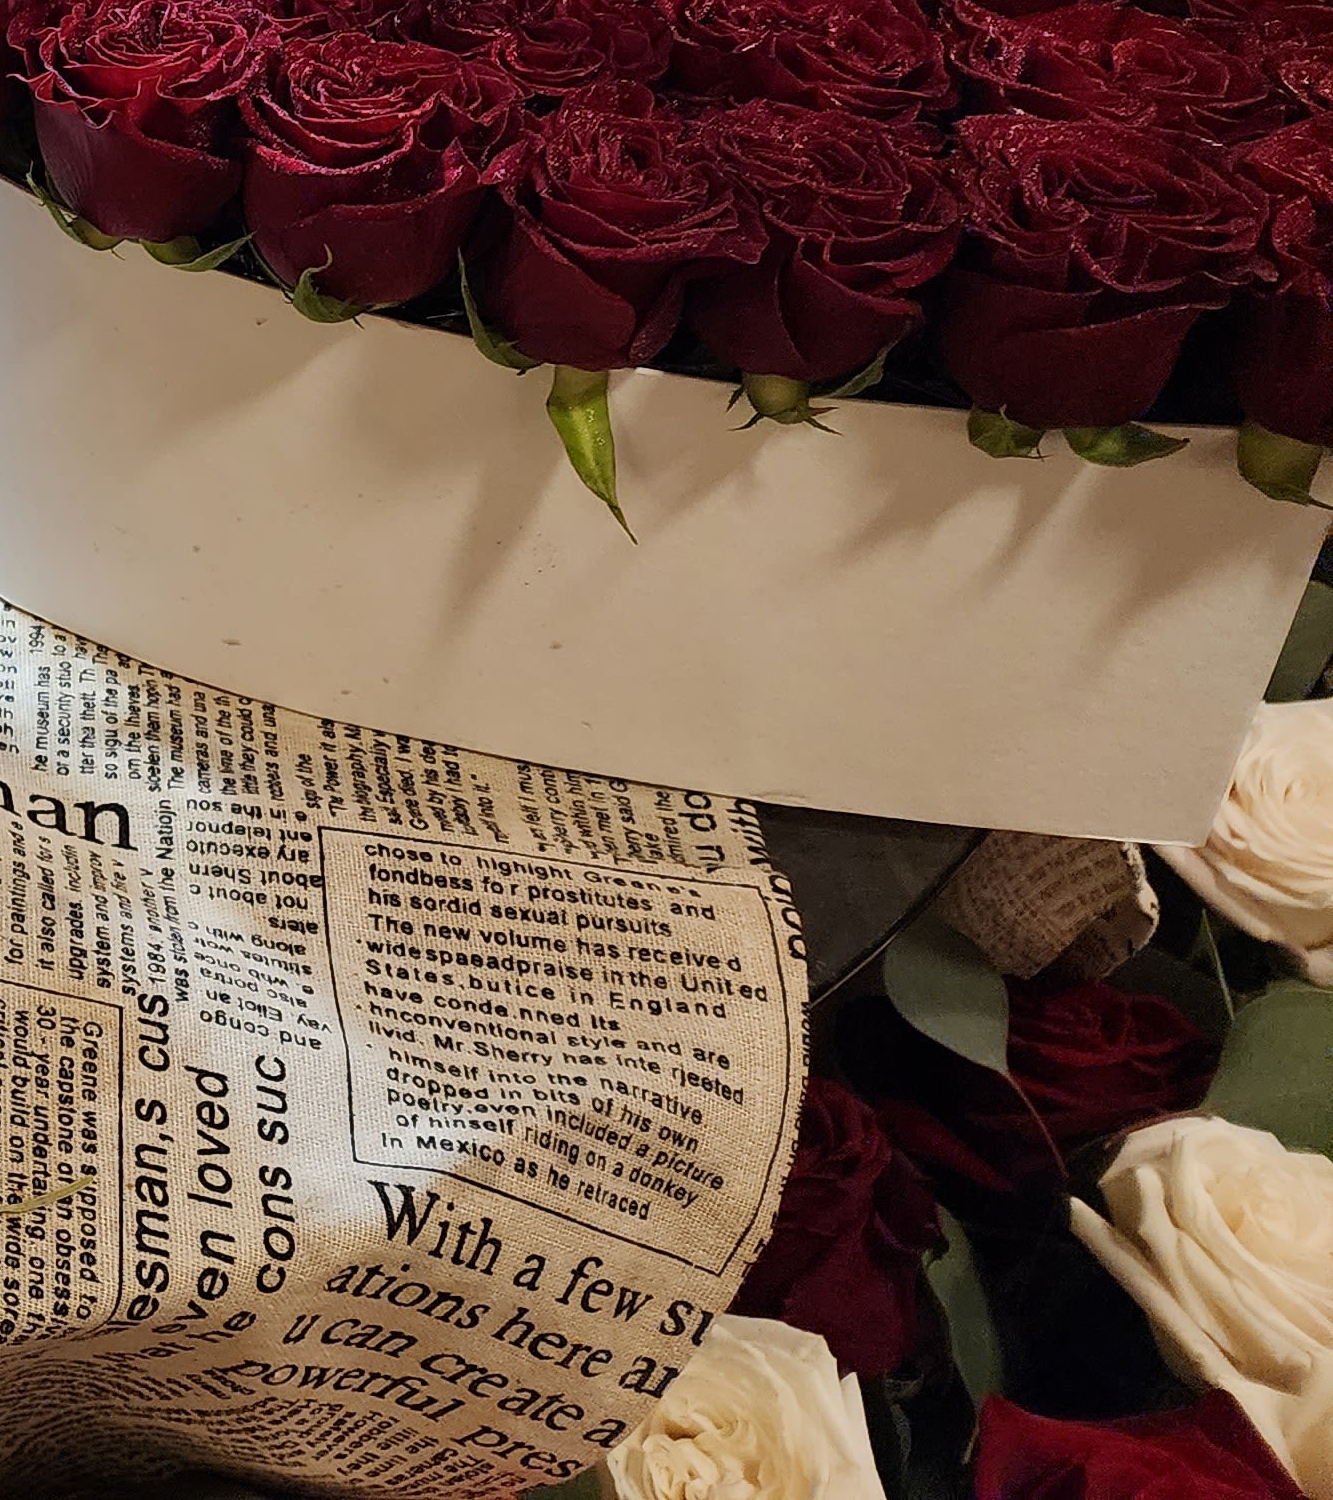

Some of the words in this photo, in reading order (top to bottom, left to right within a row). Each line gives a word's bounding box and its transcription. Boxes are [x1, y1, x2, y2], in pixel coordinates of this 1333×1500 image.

[10, 861, 31, 936] paintings
[368, 913, 413, 935] The
[424, 922, 471, 941] new
[480, 929, 567, 953] volume
[577, 937, 620, 959] has
[528, 884, 653, 911] prostitutes
[670, 902, 716, 920] and
[5, 939, 24, 965] for
[138, 993, 171, 1072] cus
[570, 987, 594, 1005] in
[609, 991, 726, 1019] England
[255, 1054, 291, 1145] suc
[389, 1047, 479, 1081] himself
[489, 1070, 537, 1084] into
[547, 1073, 588, 1086] the
[184, 1064, 234, 1210] loved
[416, 1135, 506, 1166] Mexico
[514, 1157, 538, 1177] as
[548, 1164, 570, 1190] he
[524, 1126, 579, 1165] riding
[586, 1151, 607, 1171] on
[612, 1161, 623, 1177] a
[629, 1167, 699, 1209] donkey
[256, 1164, 297, 1294] cons
[367, 1180, 503, 1276] With
[512, 1253, 548, 1292] a
[555, 1256, 655, 1323] few
[324, 1262, 493, 1330] ations
[492, 1307, 613, 1380] here
[221, 1353, 466, 1425] powerful
[454, 1424, 585, 1481] pres
[320, 1316, 418, 1361] can
[420, 1350, 586, 1433] create
[583, 1417, 628, 1449] a
